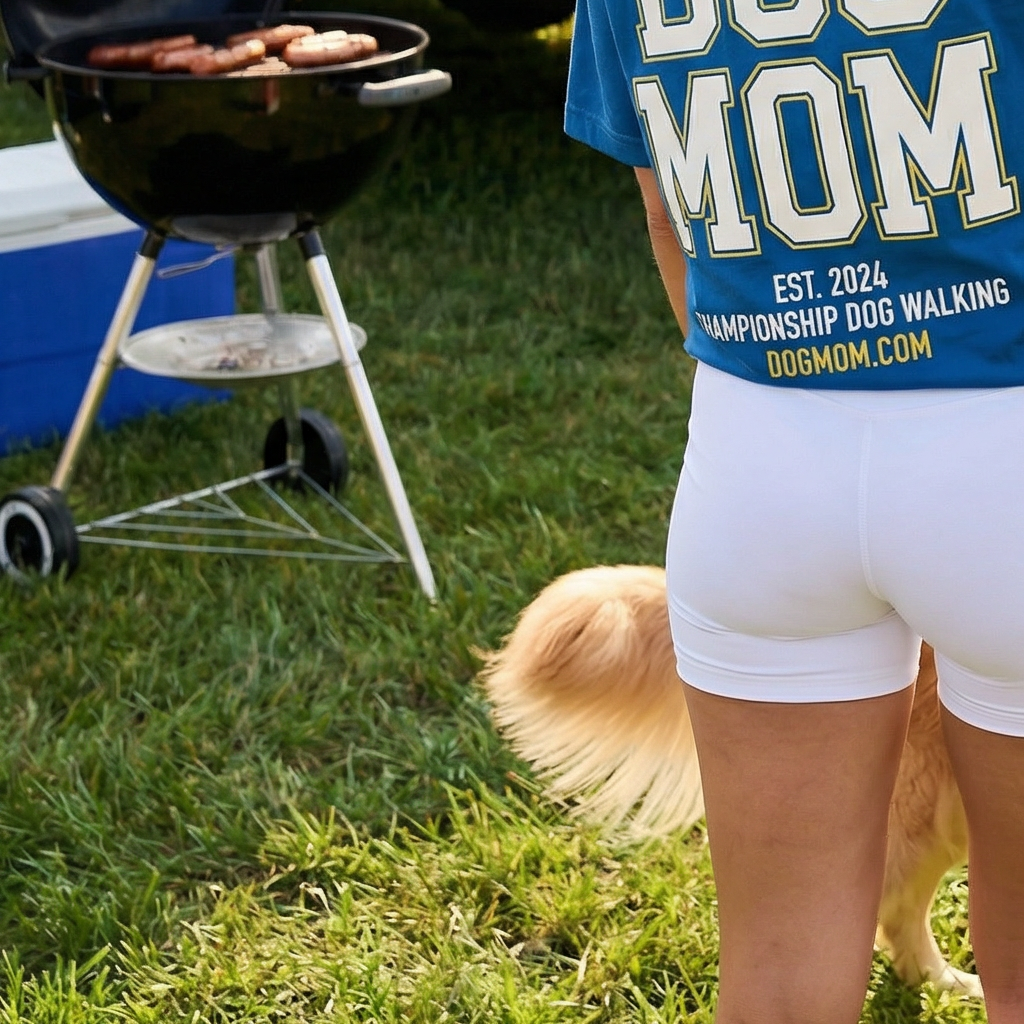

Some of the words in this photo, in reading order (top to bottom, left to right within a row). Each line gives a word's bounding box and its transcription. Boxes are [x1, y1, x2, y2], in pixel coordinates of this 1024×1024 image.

[633, 32, 1021, 259] MOM
[773, 270, 822, 303] EST.
[828, 260, 888, 297] 2024
[845, 298, 894, 332] DOG
[899, 277, 1010, 322] WALKING
[766, 329, 932, 378] DOGMOM.COM
